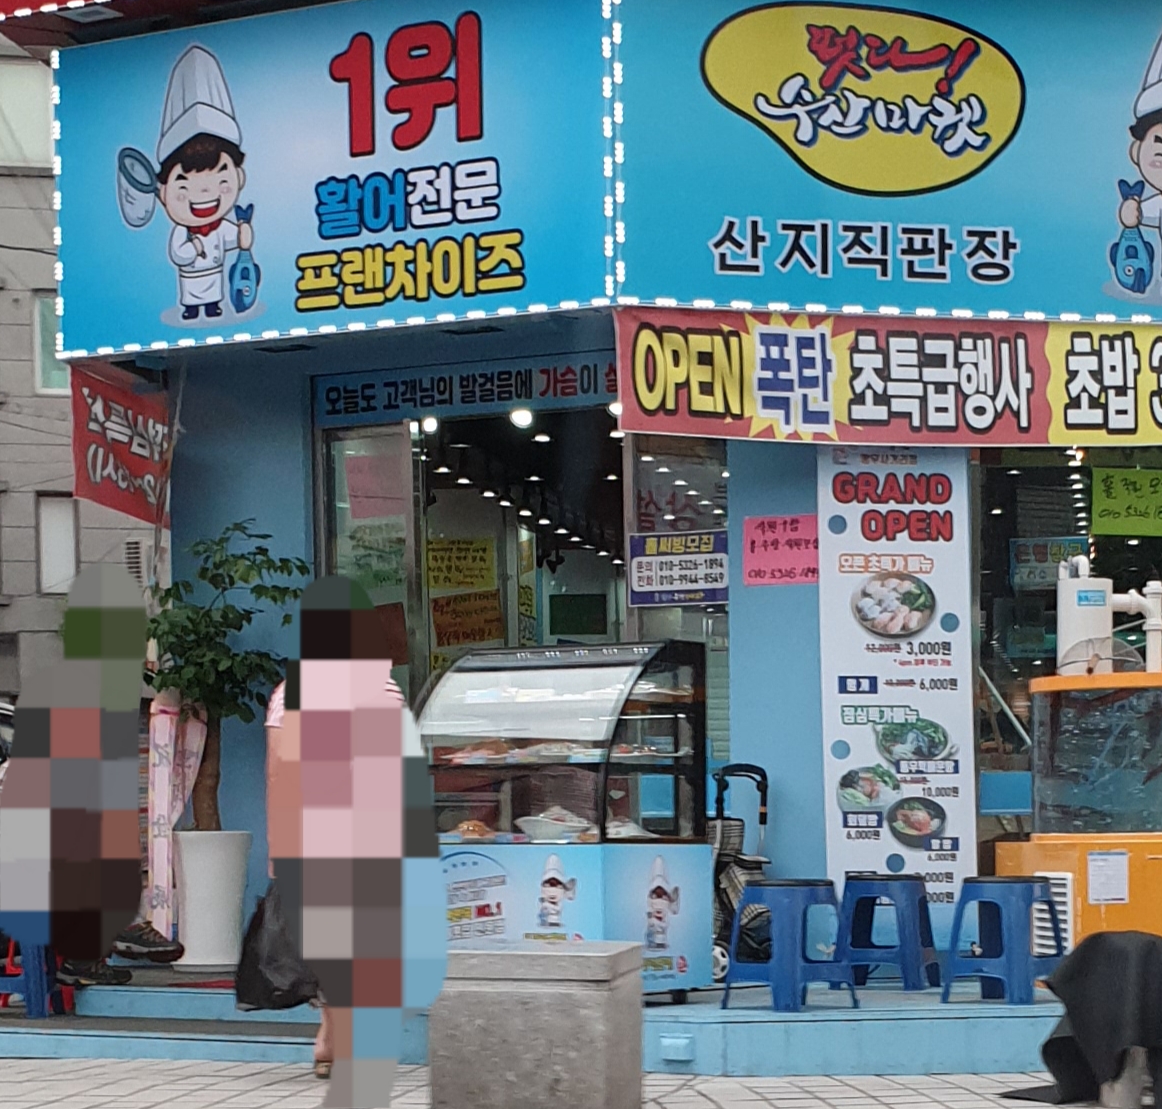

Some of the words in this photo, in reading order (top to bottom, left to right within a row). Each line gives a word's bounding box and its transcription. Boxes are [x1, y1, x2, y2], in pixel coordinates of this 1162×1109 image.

[329, 11, 485, 157] 1위
[315, 157, 501, 240] 활어전문
[295, 229, 527, 312] 프랜차이즈
[710, 216, 1020, 283] 산지직판장
[324, 382, 377, 416] 오늘도
[382, 375, 454, 410] 고객님의
[458, 368, 533, 404] 발걸음에
[539, 363, 598, 398] 가슴이
[633, 324, 745, 419] OPEN
[753, 324, 837, 433] 폭탄
[849, 329, 1034, 433] 초특급행사
[1065, 331, 1141, 435] 초밥
[832, 471, 953, 504] GRAND
[861, 509, 954, 542] OPEN
[907, 641, 952, 657] 3,000원
[919, 677, 958, 692] 6,000원
